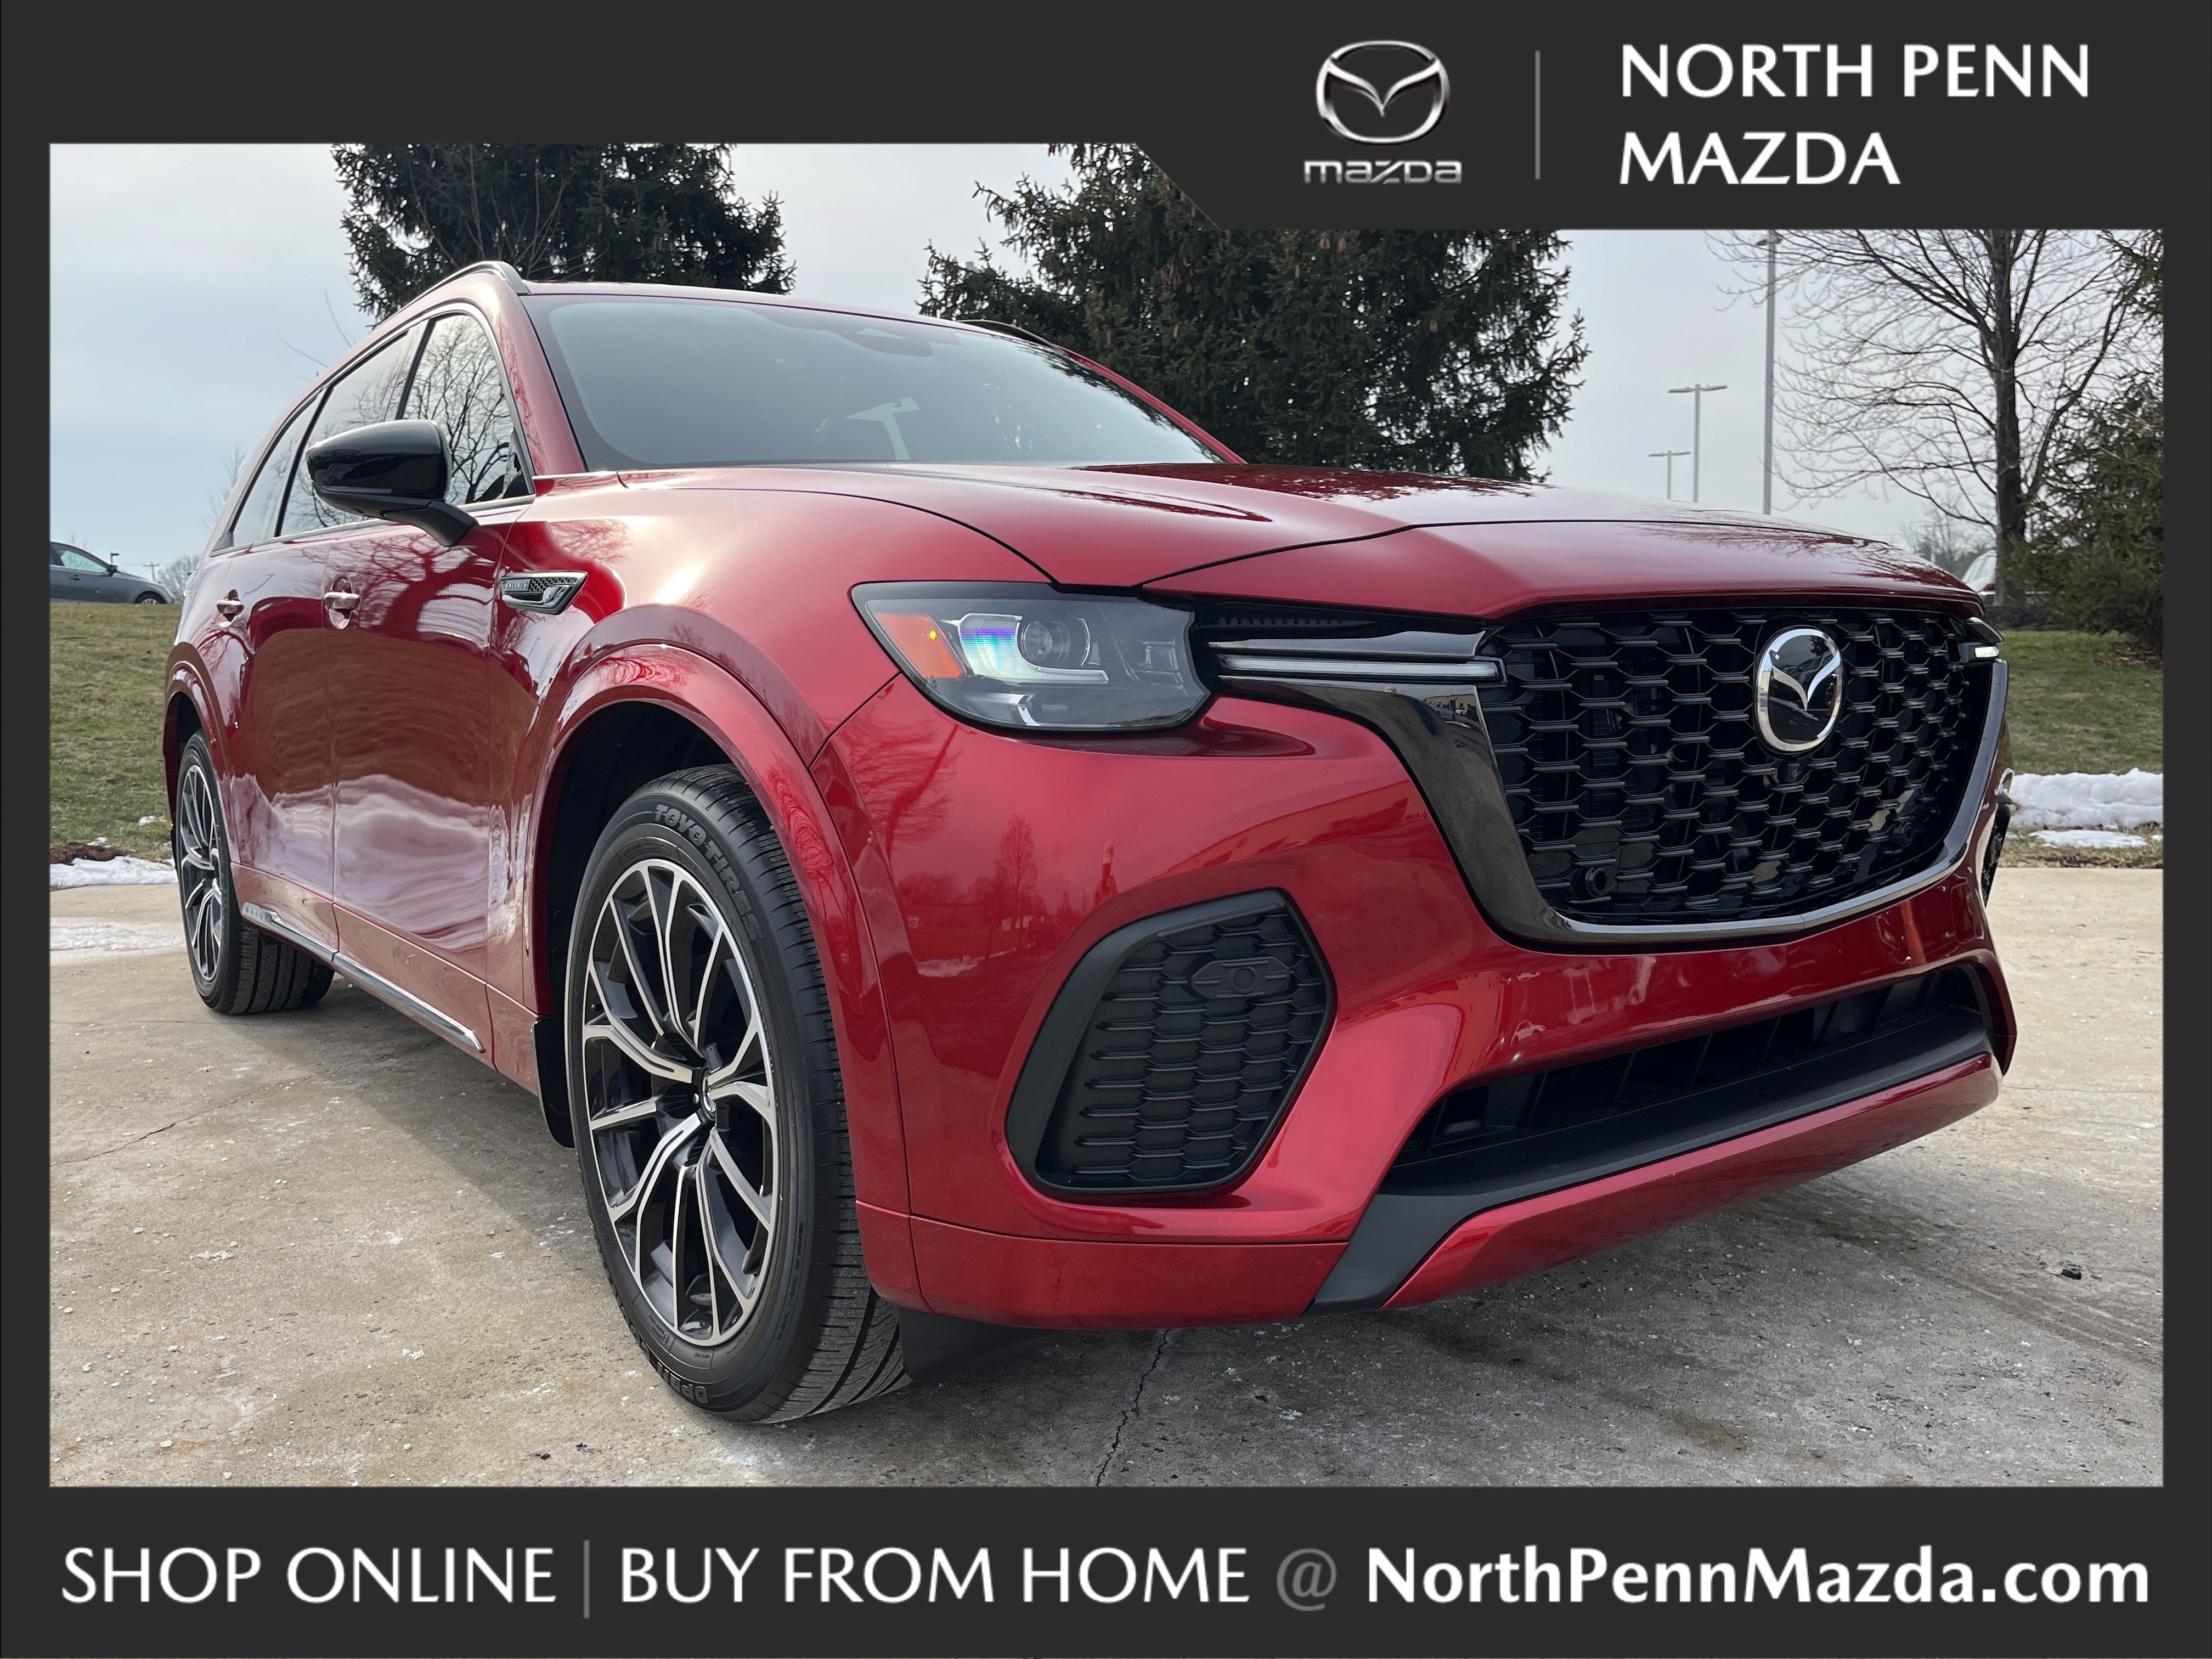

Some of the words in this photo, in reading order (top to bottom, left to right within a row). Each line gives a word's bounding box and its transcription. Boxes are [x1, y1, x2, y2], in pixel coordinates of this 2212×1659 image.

[654, 804, 707, 847] TOYO
[704, 839, 764, 941] TIRES
[657, 1362, 708, 1404] OPEN
